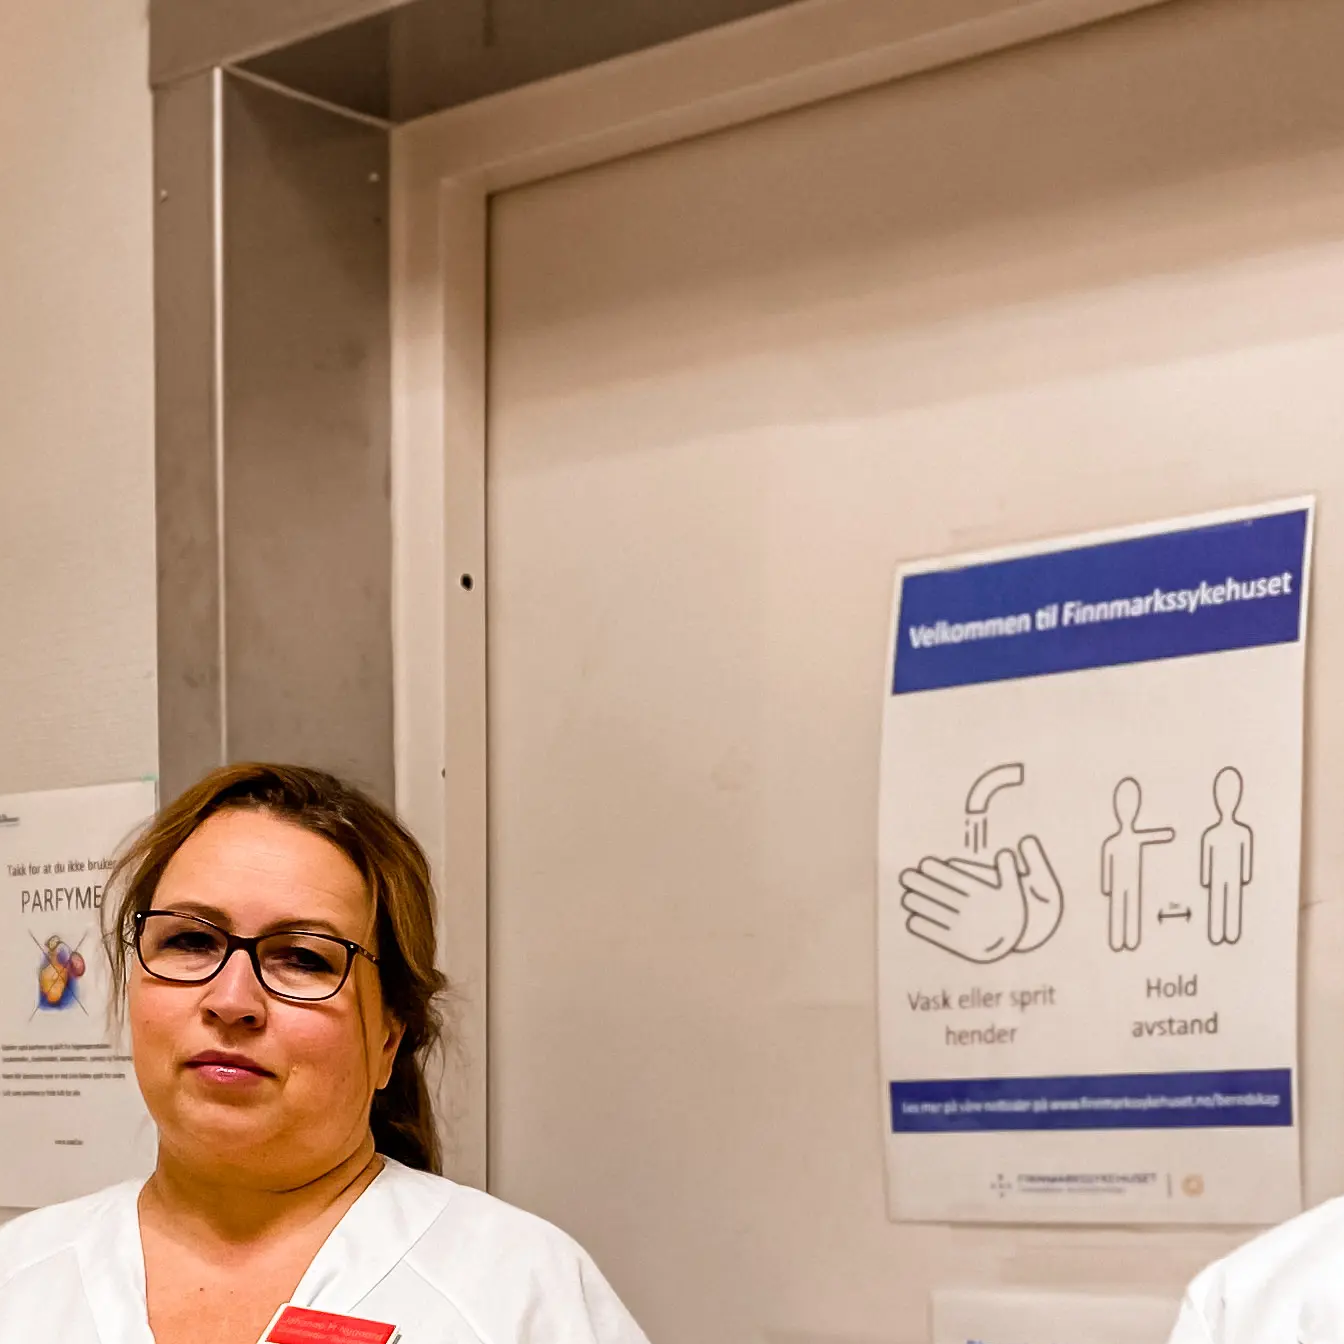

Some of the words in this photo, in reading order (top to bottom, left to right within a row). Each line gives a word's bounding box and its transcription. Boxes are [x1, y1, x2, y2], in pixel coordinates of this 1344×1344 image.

[908, 613, 1032, 649] Velkommen
[1034, 603, 1059, 631] til
[1061, 570, 1293, 627] Finnmarkssykehuset
[7, 864, 27, 877] Takk
[28, 863, 41, 876] for
[43, 863, 52, 875] at
[54, 862, 66, 874] du
[67, 860, 85, 873] ikke
[21, 885, 102, 913] PARFYME
[907, 990, 952, 1012] Vask
[957, 987, 1003, 1010] eller
[1009, 985, 1056, 1013] sprit
[1146, 974, 1198, 998] Hold
[945, 1024, 1017, 1046] hender
[1131, 1010, 1219, 1038] avstand
